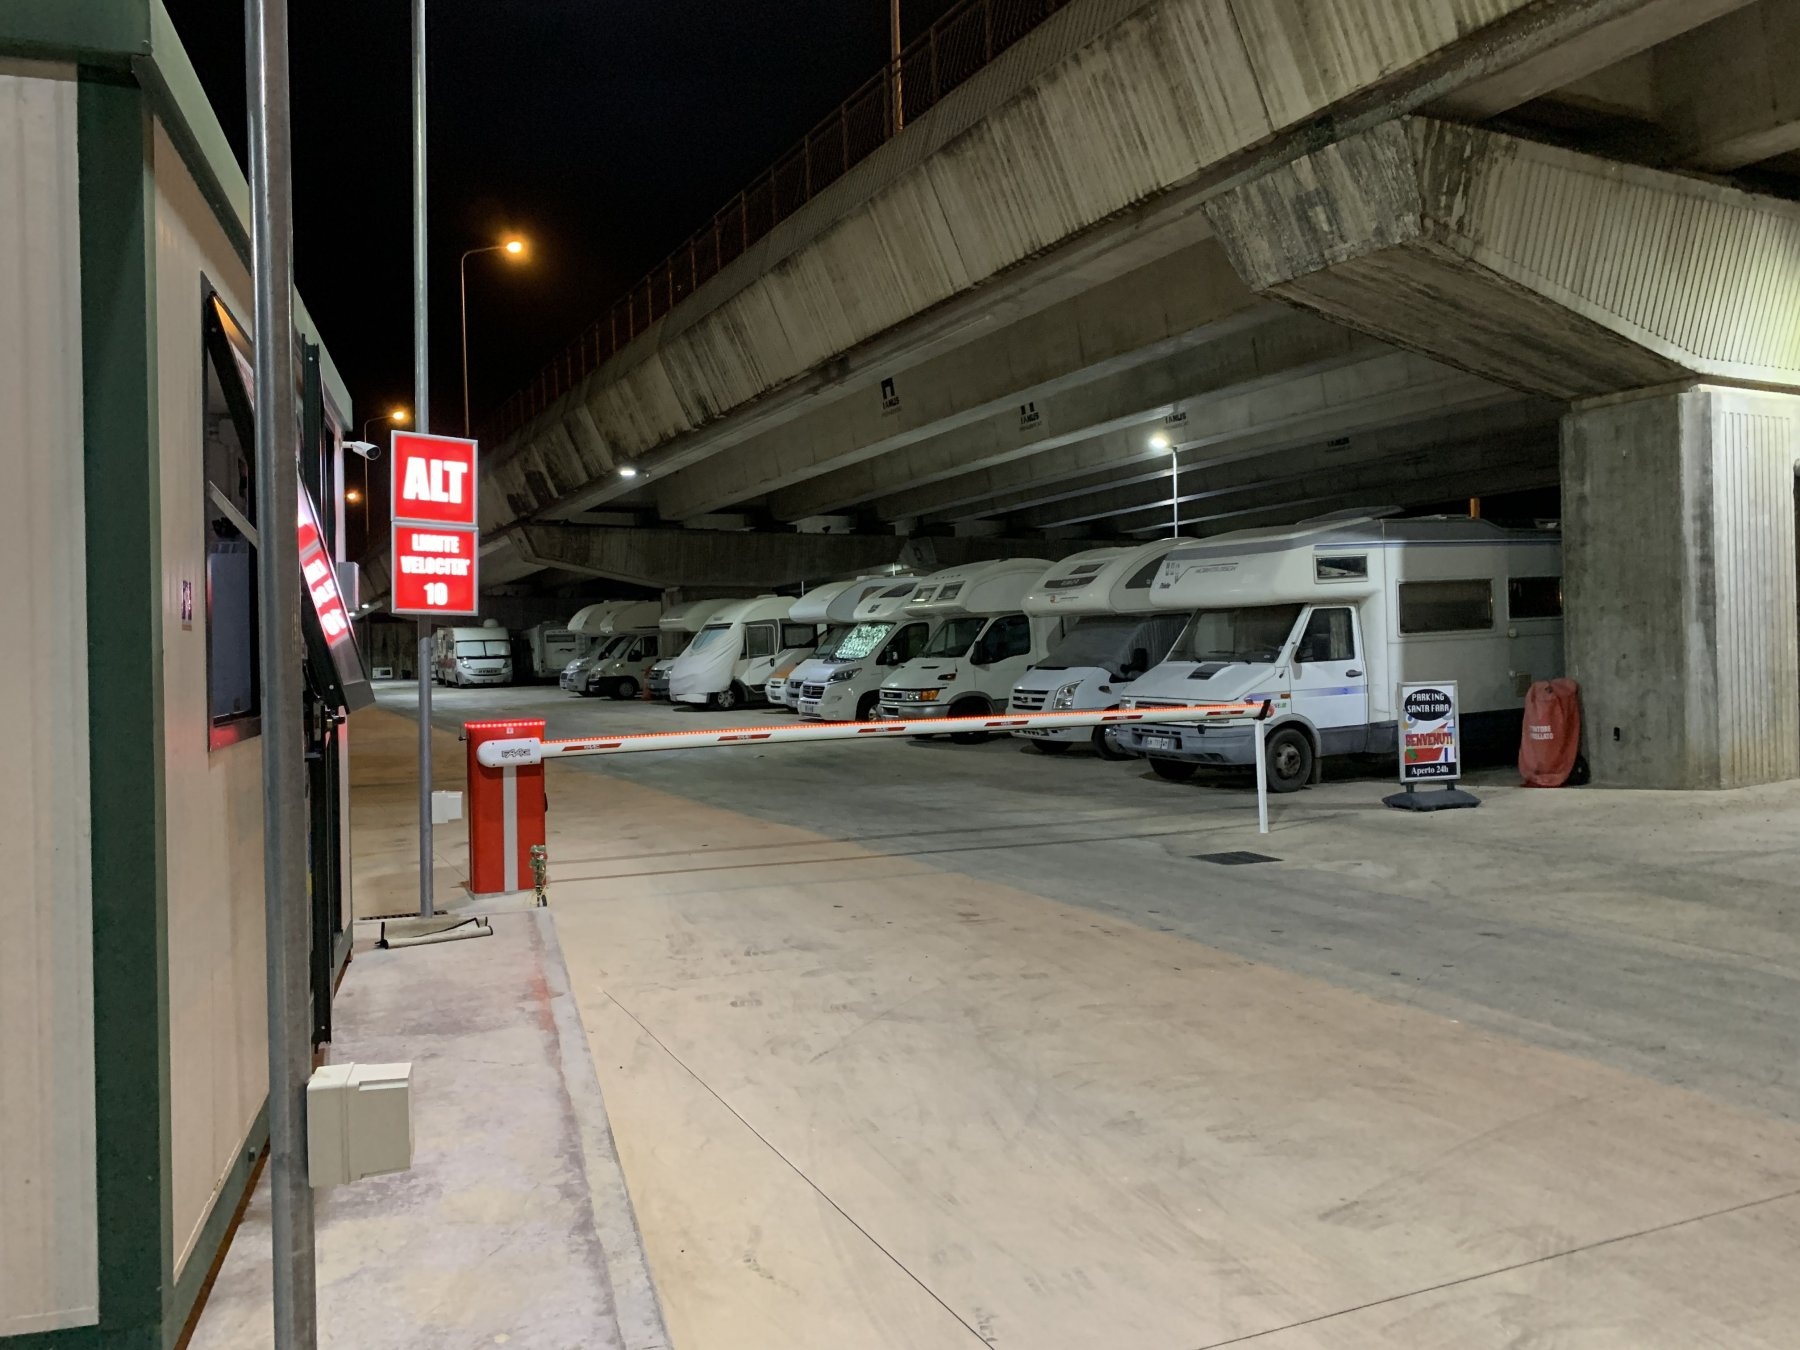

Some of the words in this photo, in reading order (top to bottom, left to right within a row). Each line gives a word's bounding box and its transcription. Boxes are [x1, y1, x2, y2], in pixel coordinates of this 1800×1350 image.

[403, 456, 468, 504] ALT
[411, 533, 460, 553] LIMITE
[423, 582, 448, 606] 10
[1411, 692, 1445, 702] PARKING
[1407, 704, 1429, 713] SANTA
[1431, 703, 1450, 713] FARA
[1405, 732, 1453, 747] BENVENUTI
[1411, 766, 1435, 777] Aperto
[1436, 765, 1449, 774] 24h
